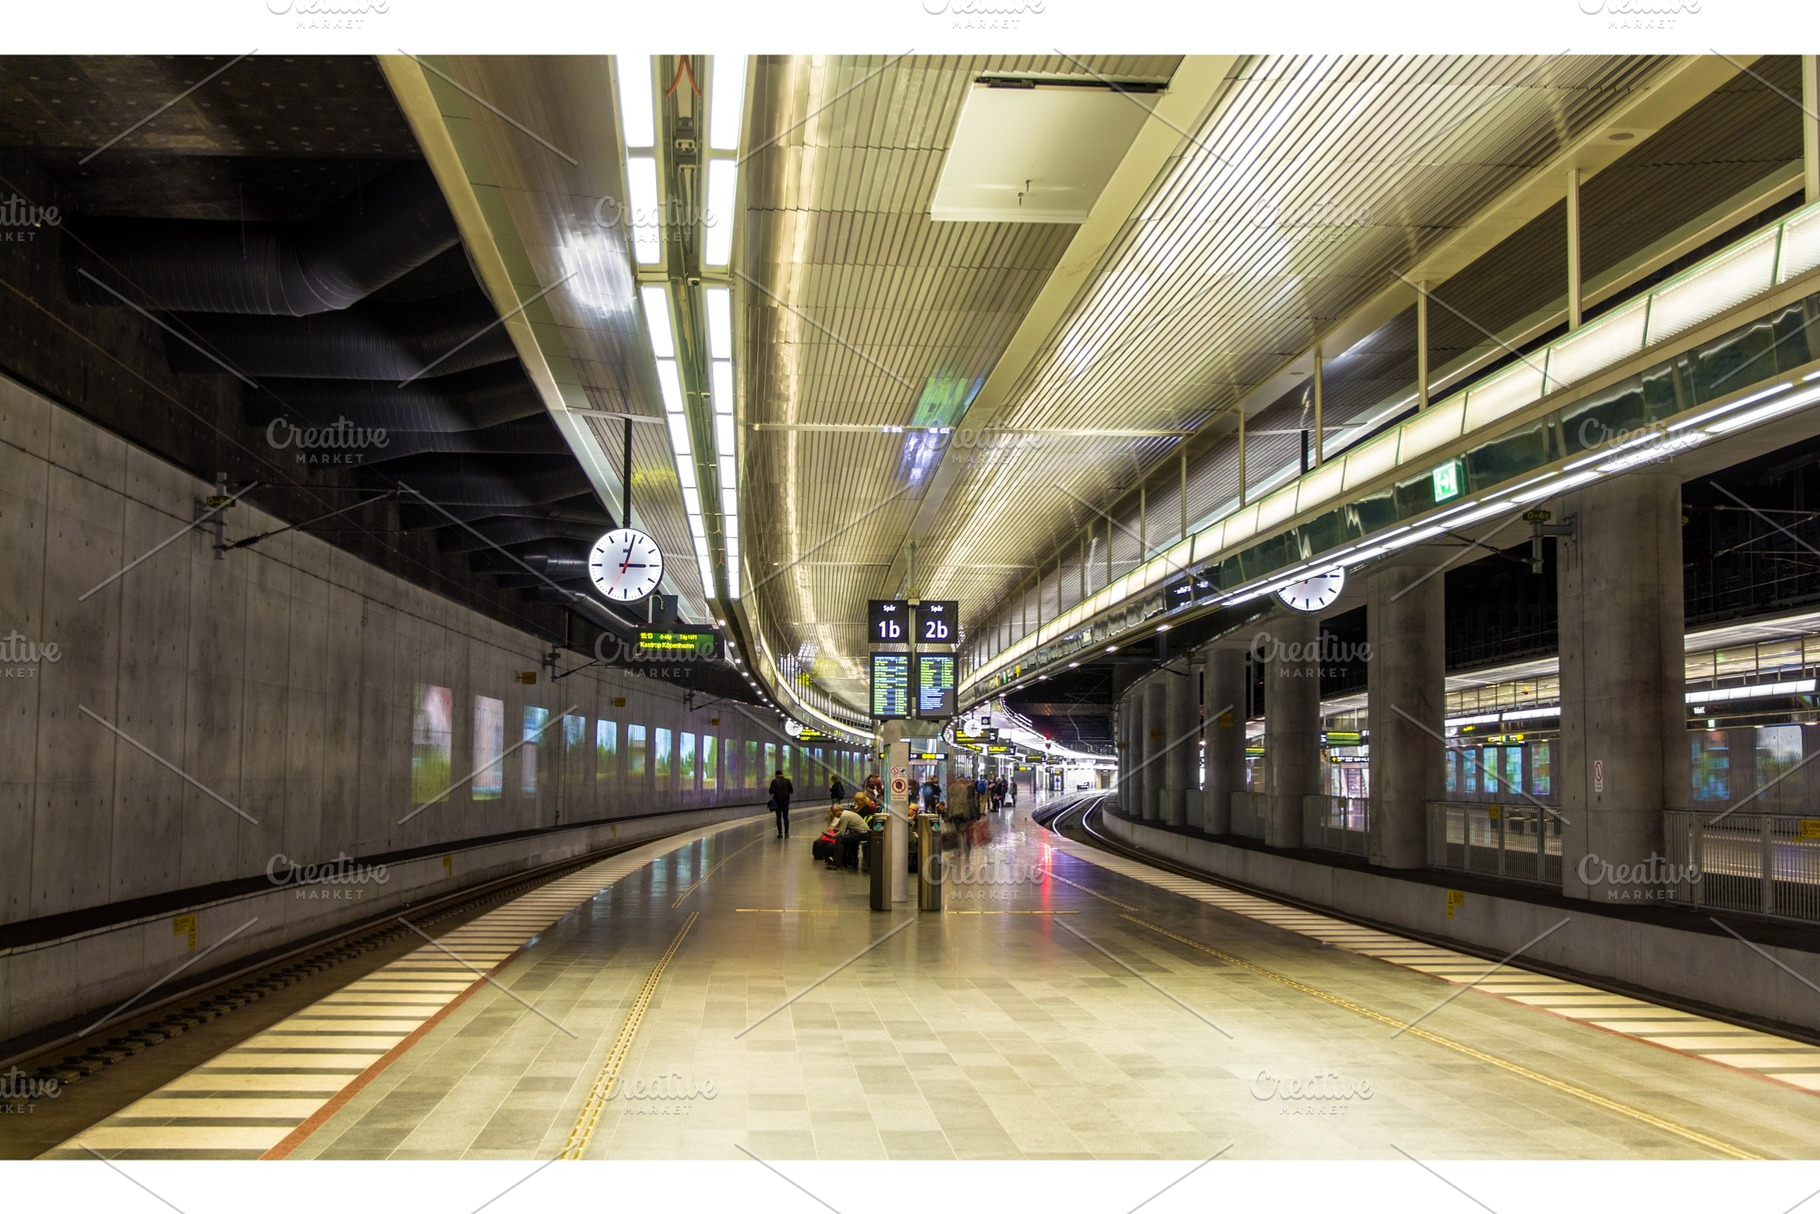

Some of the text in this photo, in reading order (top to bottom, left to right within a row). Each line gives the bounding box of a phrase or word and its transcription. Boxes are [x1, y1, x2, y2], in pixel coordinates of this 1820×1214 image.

[883, 604, 896, 613] Spår
[930, 605, 943, 613] Spår
[879, 620, 900, 638] 1b
[925, 620, 948, 639] 2b
[640, 642, 695, 650] Kastrup Köpenhamn
